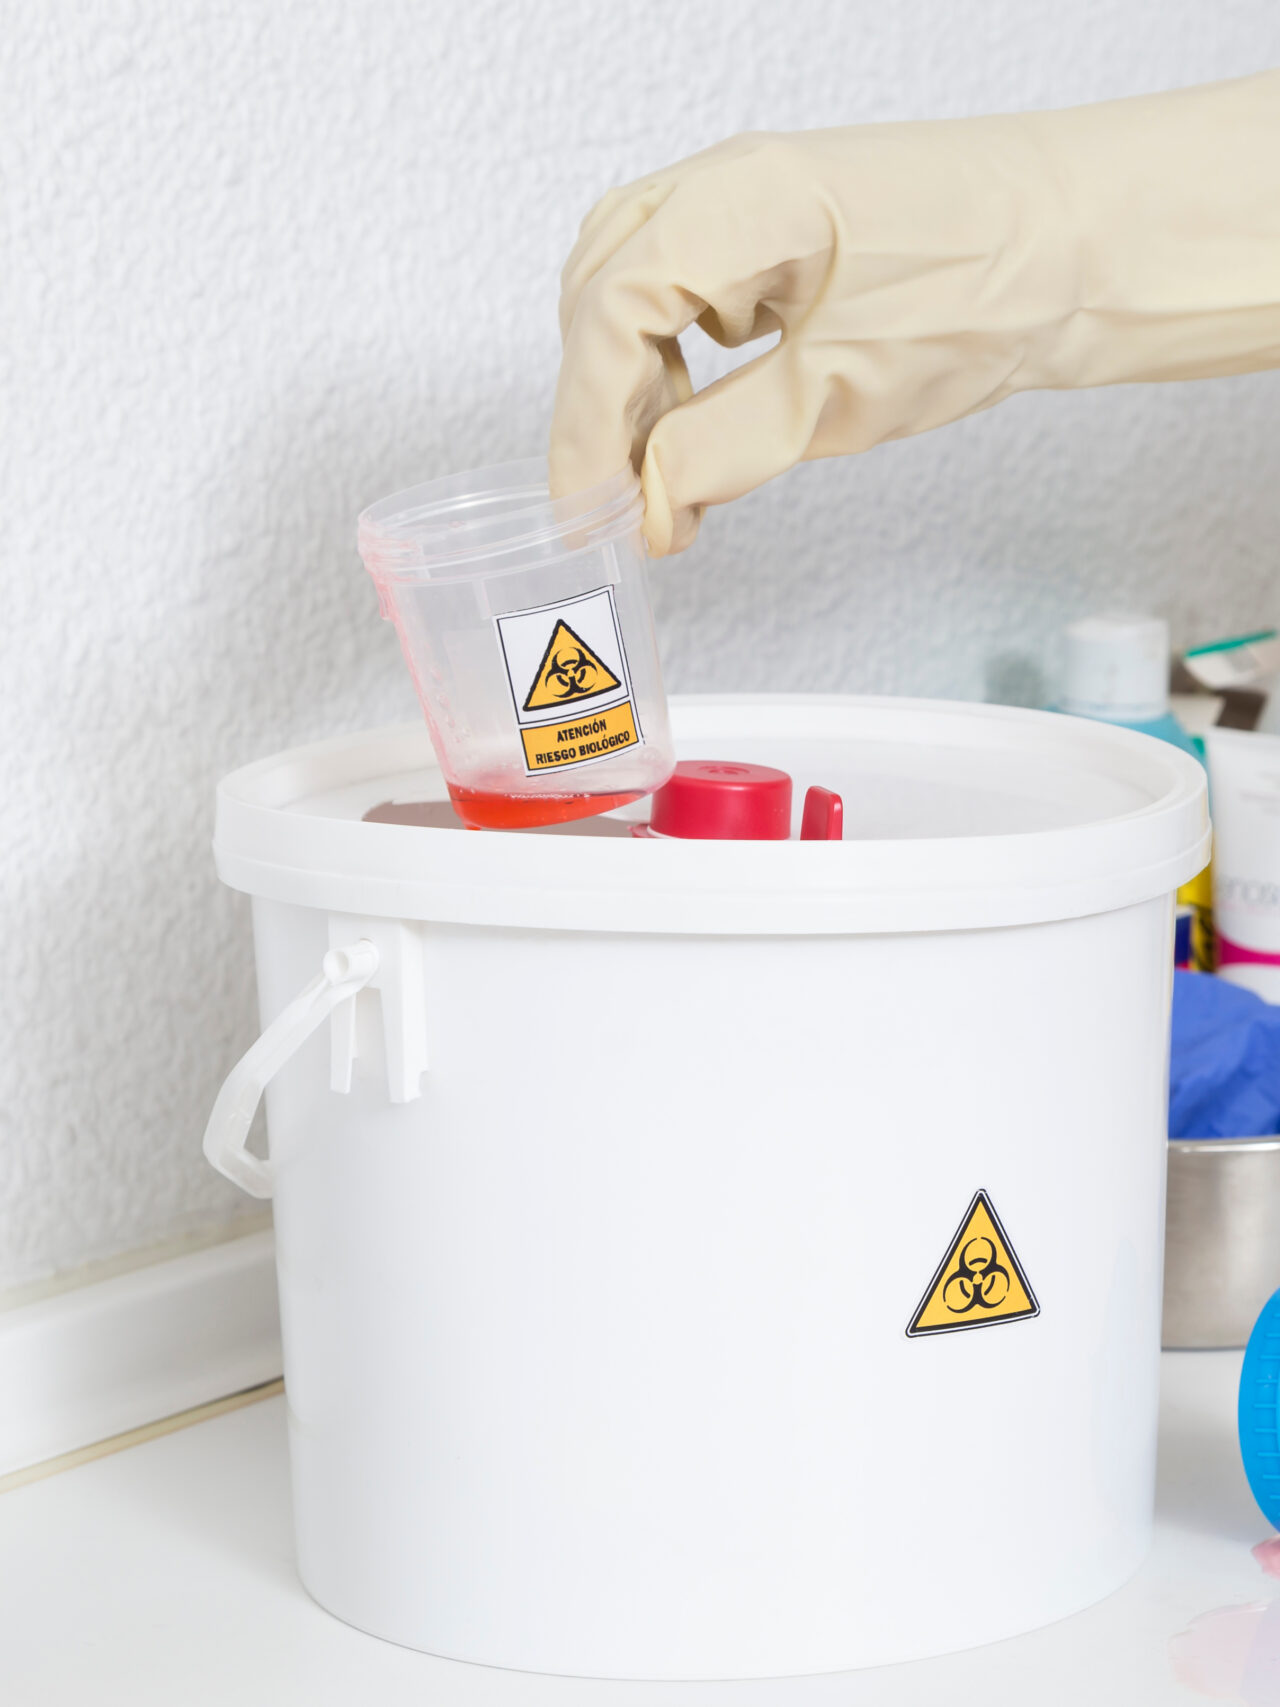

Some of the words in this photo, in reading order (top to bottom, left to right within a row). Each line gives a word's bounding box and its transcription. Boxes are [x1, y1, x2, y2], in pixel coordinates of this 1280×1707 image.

[557, 719, 607, 743] ATENCIÓN
[536, 748, 576, 764] RIESGO
[580, 731, 630, 756] BIOLÓGICO
